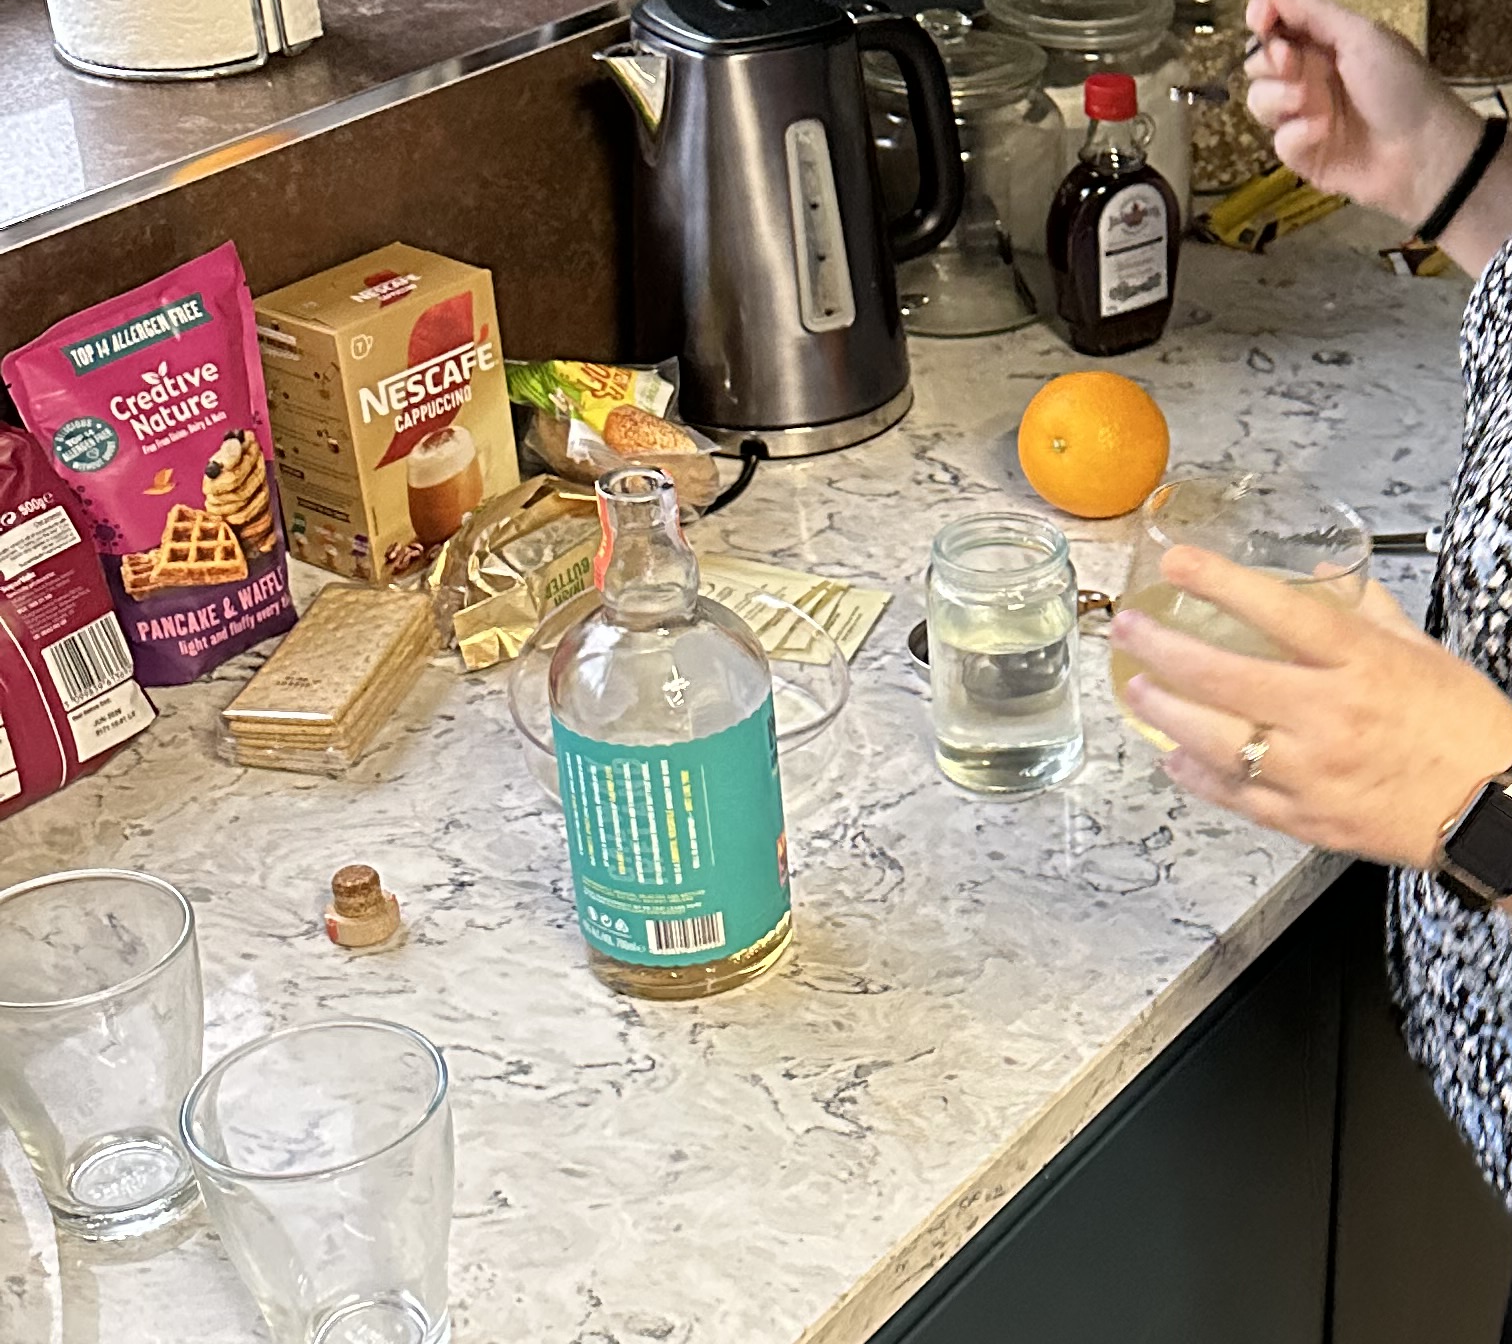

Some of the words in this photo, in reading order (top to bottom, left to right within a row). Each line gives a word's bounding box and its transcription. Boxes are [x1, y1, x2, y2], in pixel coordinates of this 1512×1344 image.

[70, 344, 94, 368] TOP
[96, 338, 110, 359] 14
[111, 314, 171, 353] ALLERGEN
[167, 300, 203, 328] FREE
[110, 362, 219, 421] Creative
[129, 390, 219, 441] Nature
[395, 385, 472, 433] CAPPUCCINO
[136, 604, 220, 642] PANCAKE
[223, 596, 238, 619] &
[178, 636, 209, 657] light
[210, 628, 229, 646] and
[229, 614, 255, 638] fluffy
[256, 602, 280, 623] every
